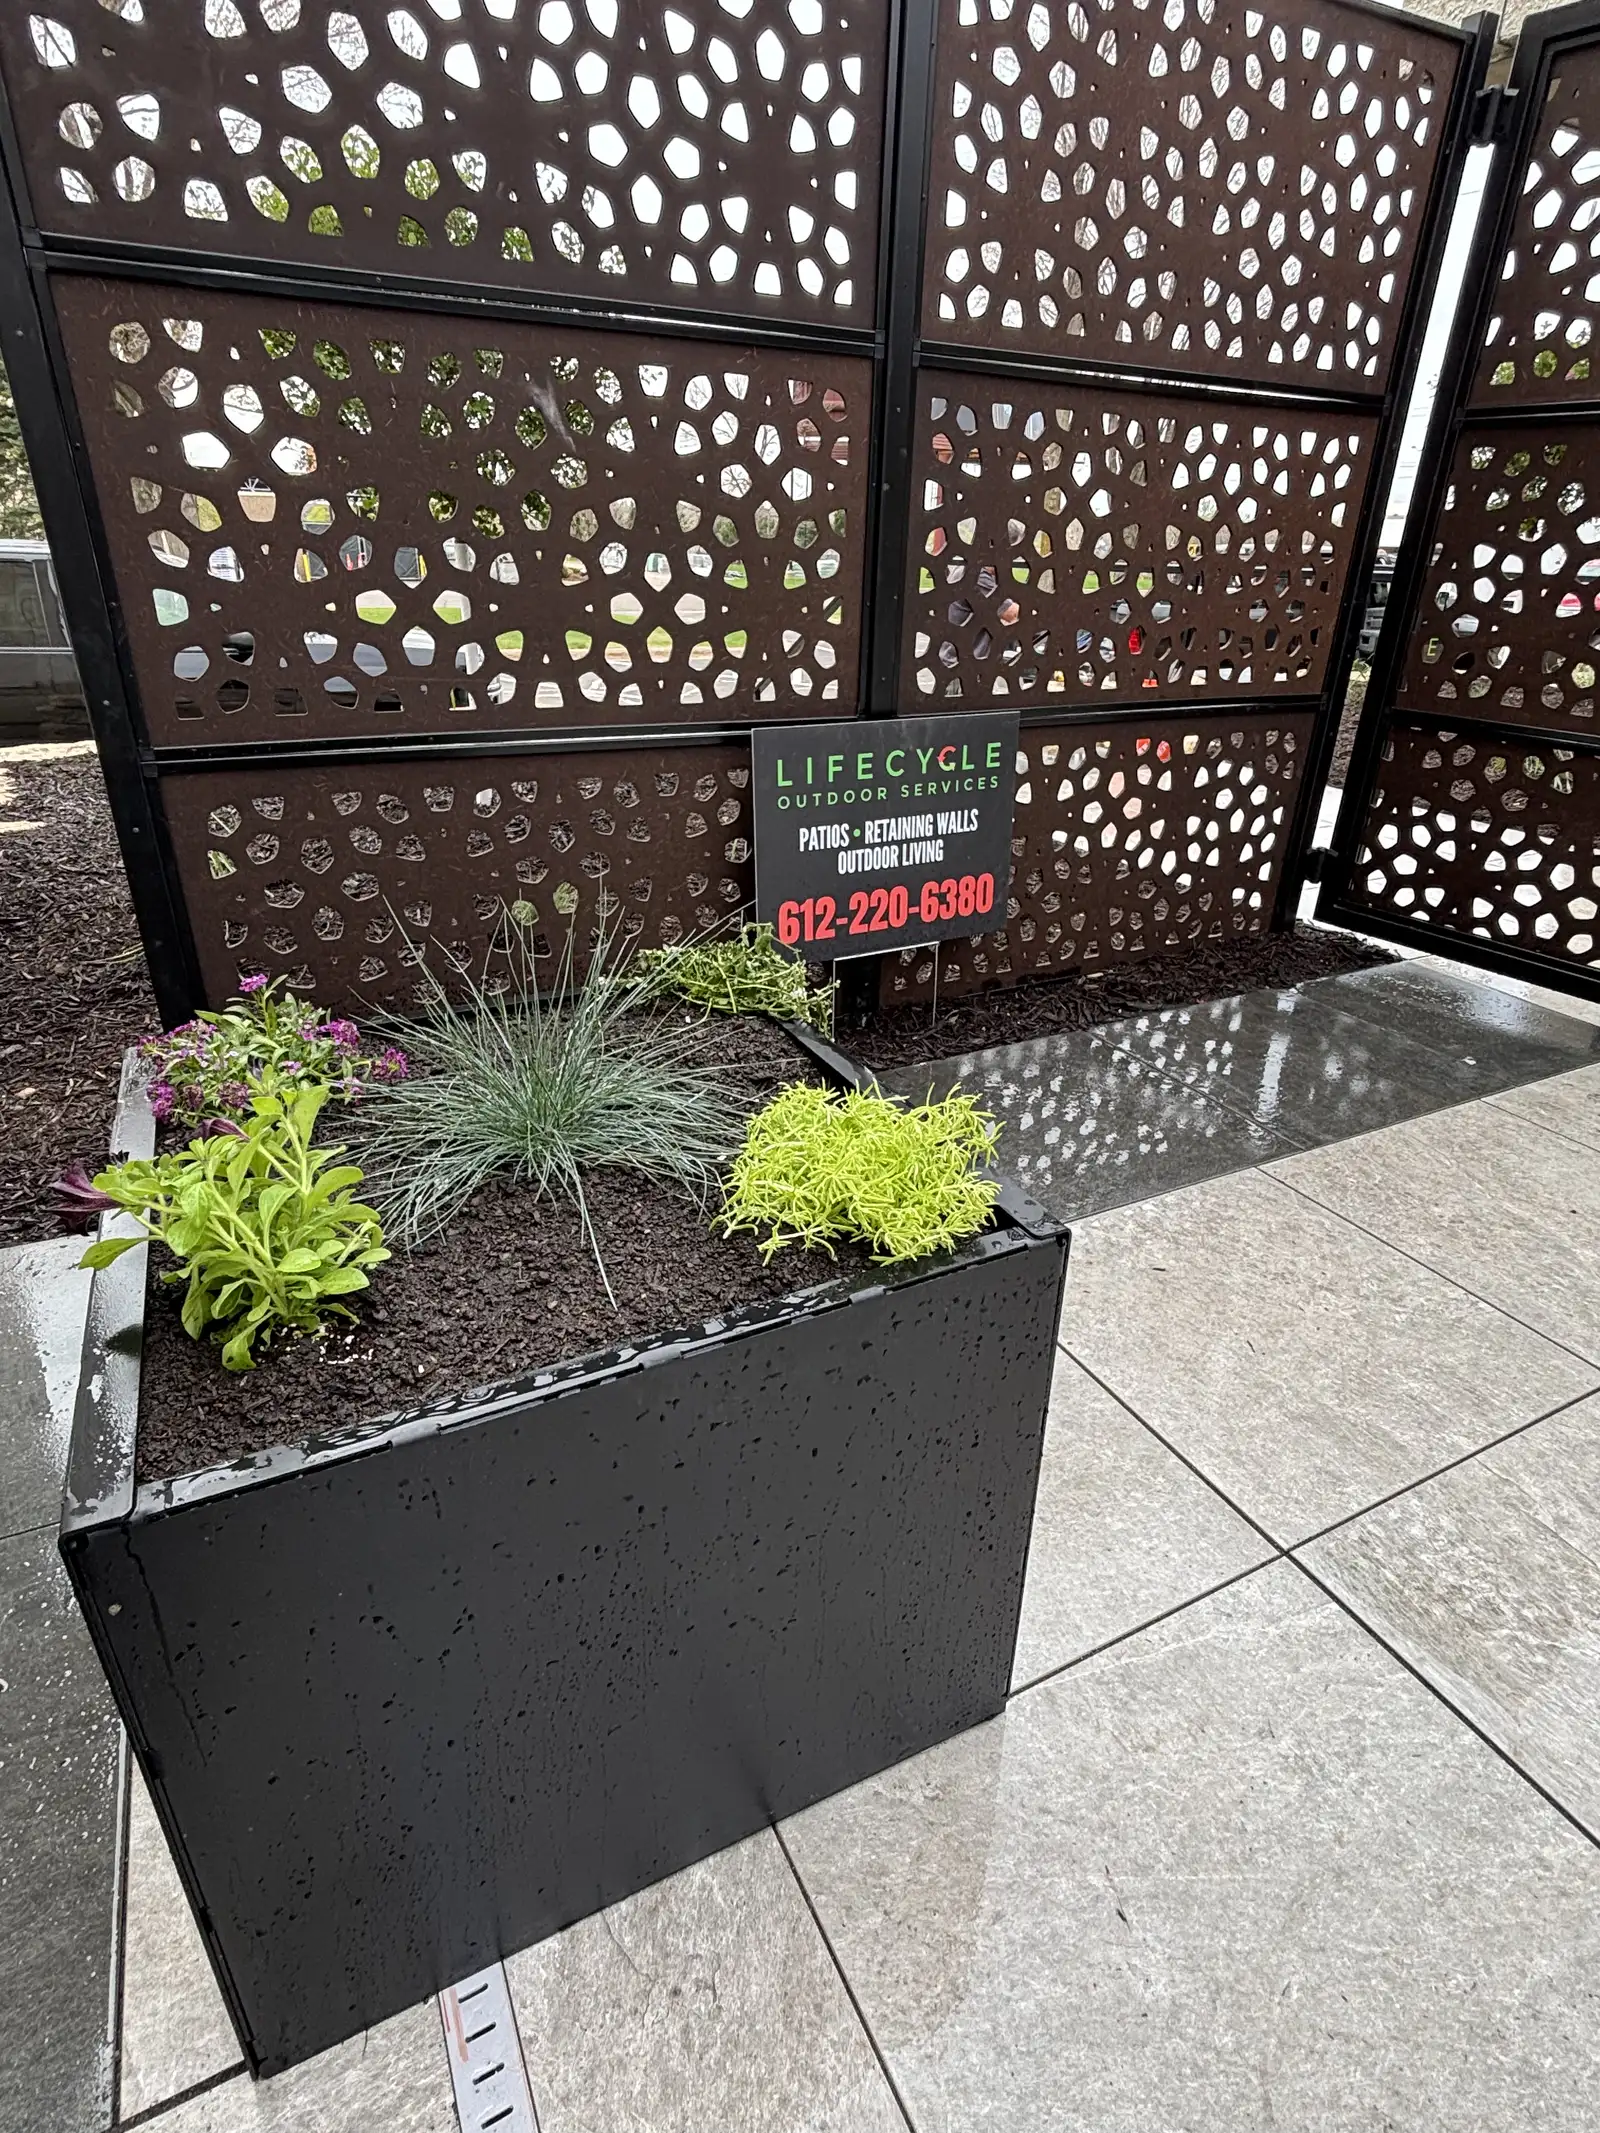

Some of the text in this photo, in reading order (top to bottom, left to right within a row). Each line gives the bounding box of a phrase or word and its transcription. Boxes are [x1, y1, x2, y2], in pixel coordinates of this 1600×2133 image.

[776, 742, 1002, 787] LIFECYCLE
[777, 775, 999, 810] OUTDOOR SERVICES
[799, 808, 979, 852] PATIOS RETAINING WALLS
[837, 840, 944, 875] OUTDOOR LIVING
[778, 872, 995, 945] 612-220-6380
